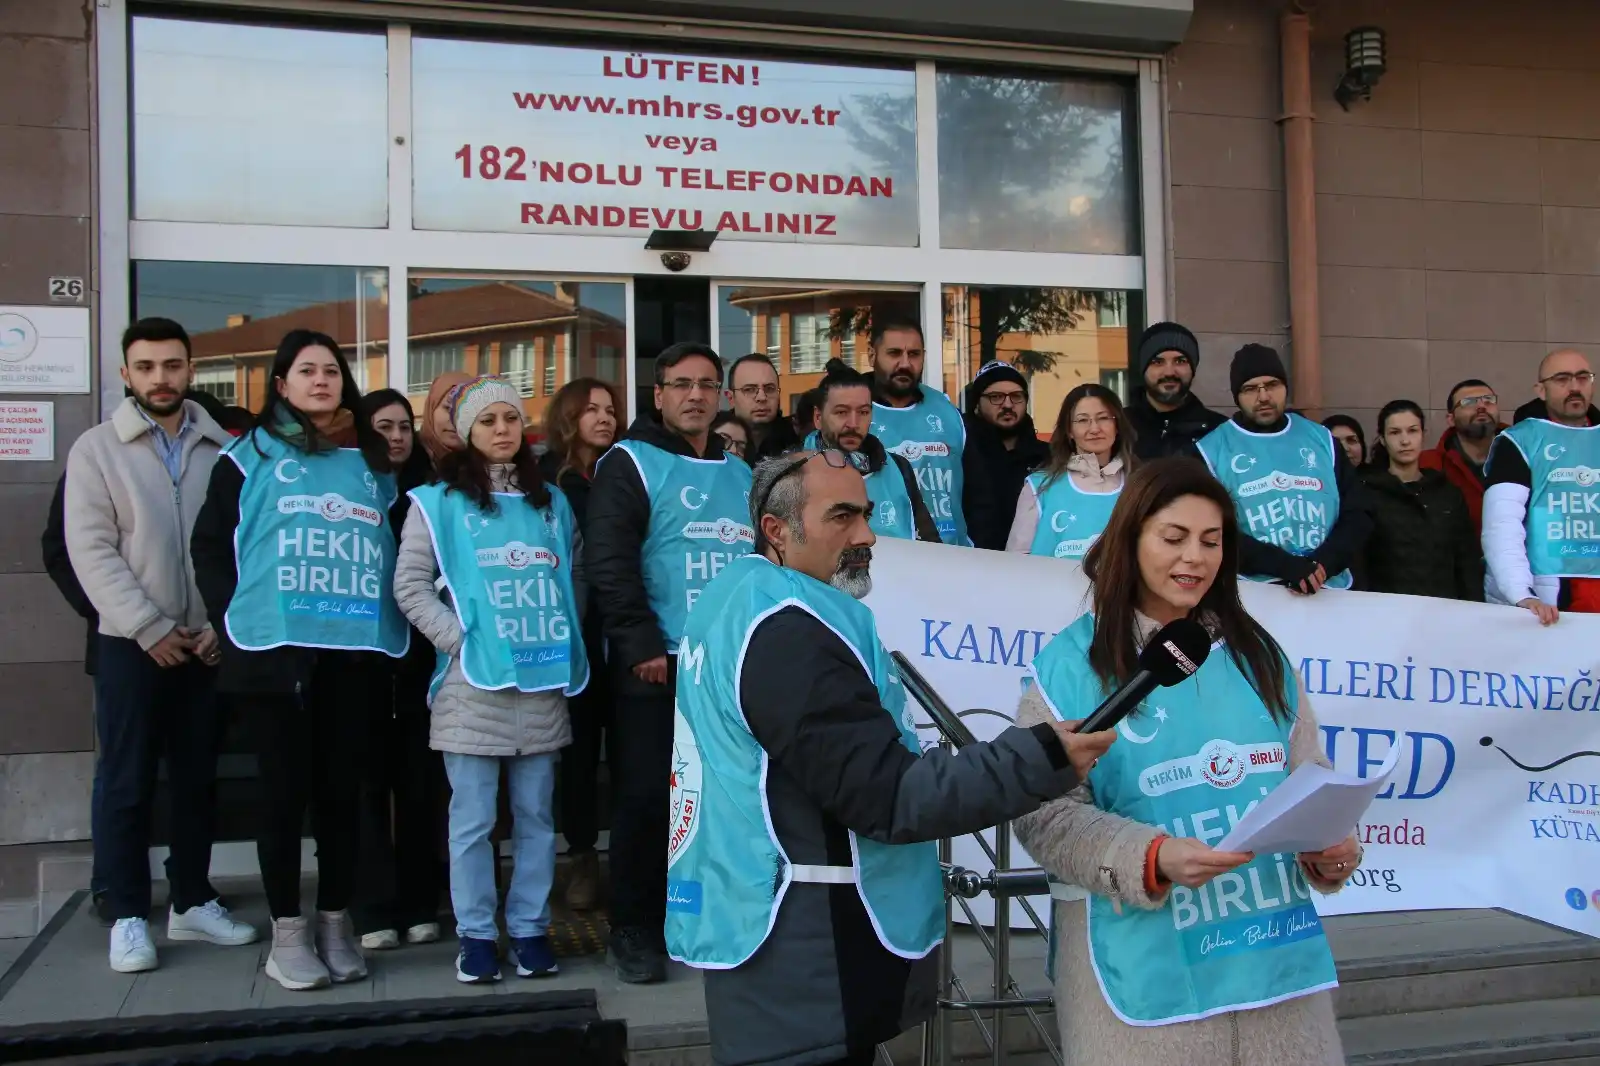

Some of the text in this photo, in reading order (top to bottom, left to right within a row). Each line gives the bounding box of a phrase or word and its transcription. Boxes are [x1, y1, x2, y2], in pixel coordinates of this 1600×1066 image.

[603, 53, 760, 86] LÜTFEN!
[512, 91, 841, 127] www.mhrs.gov.tr
[645, 133, 718, 155] veya
[656, 166, 893, 198] TELEFONDAN
[520, 203, 837, 235] RANDEVU ALINIZ
[51, 279, 82, 296] 26
[912, 463, 953, 492] KİM
[1245, 494, 1326, 532] HEKİM
[278, 527, 383, 570] HEKİM
[277, 560, 381, 599] BİRLİĞ
[1147, 765, 1193, 788] HEKİM
[1529, 814, 1600, 842] KÜTA
